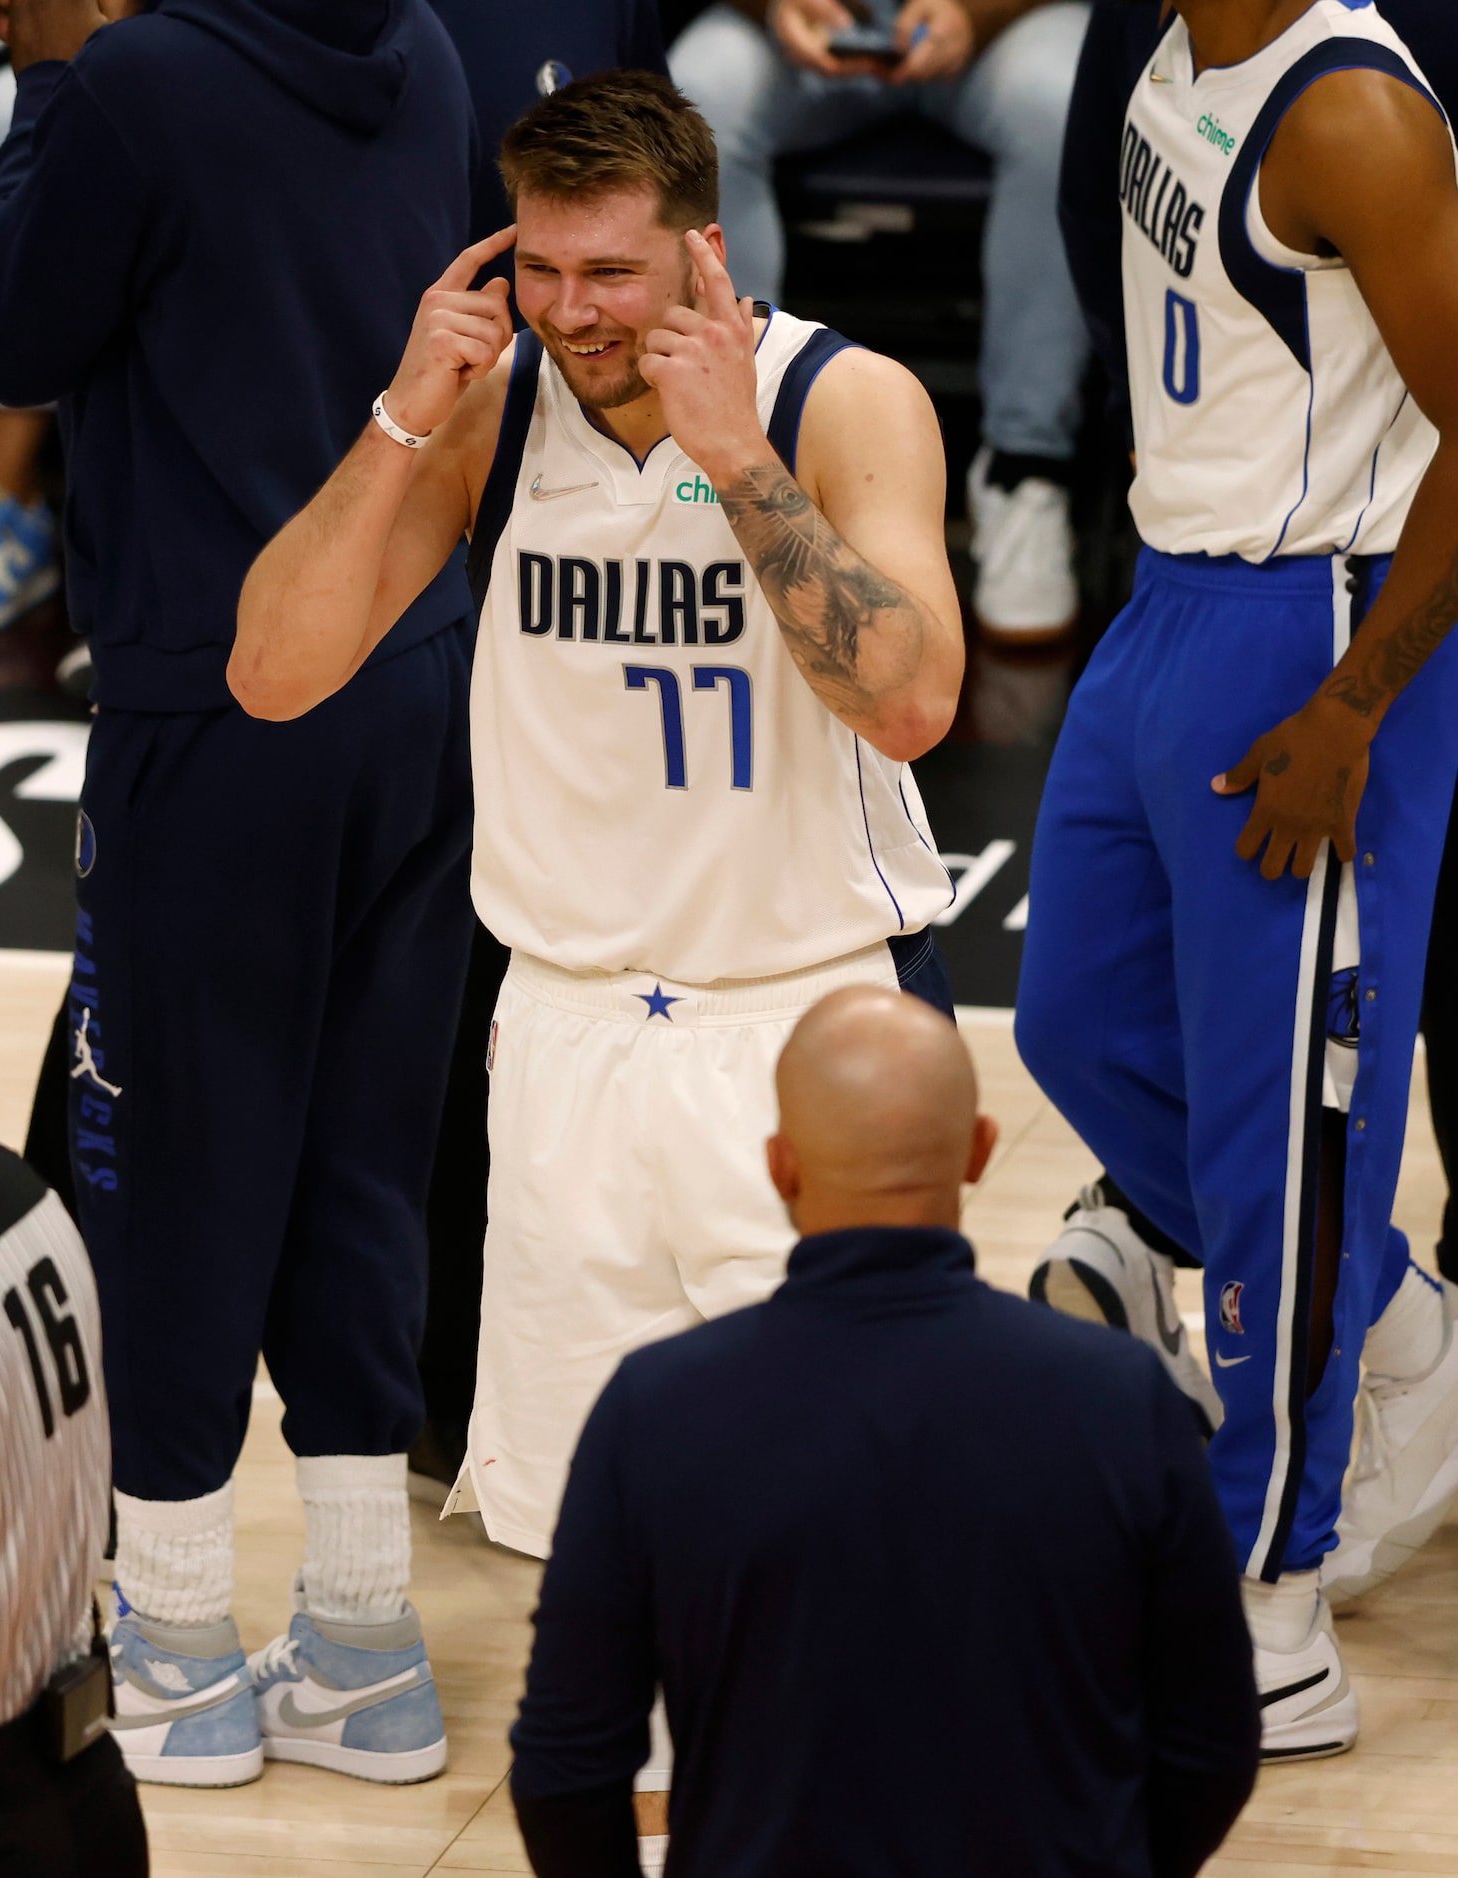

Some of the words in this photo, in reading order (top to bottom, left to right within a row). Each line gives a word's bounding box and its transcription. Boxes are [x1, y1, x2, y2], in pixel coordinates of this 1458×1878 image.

[1197, 111, 1235, 156] chime
[1163, 286, 1200, 406] 0
[518, 548, 746, 647] DALLAS
[623, 663, 754, 792] 77
[2, 1255, 90, 1440] 16
